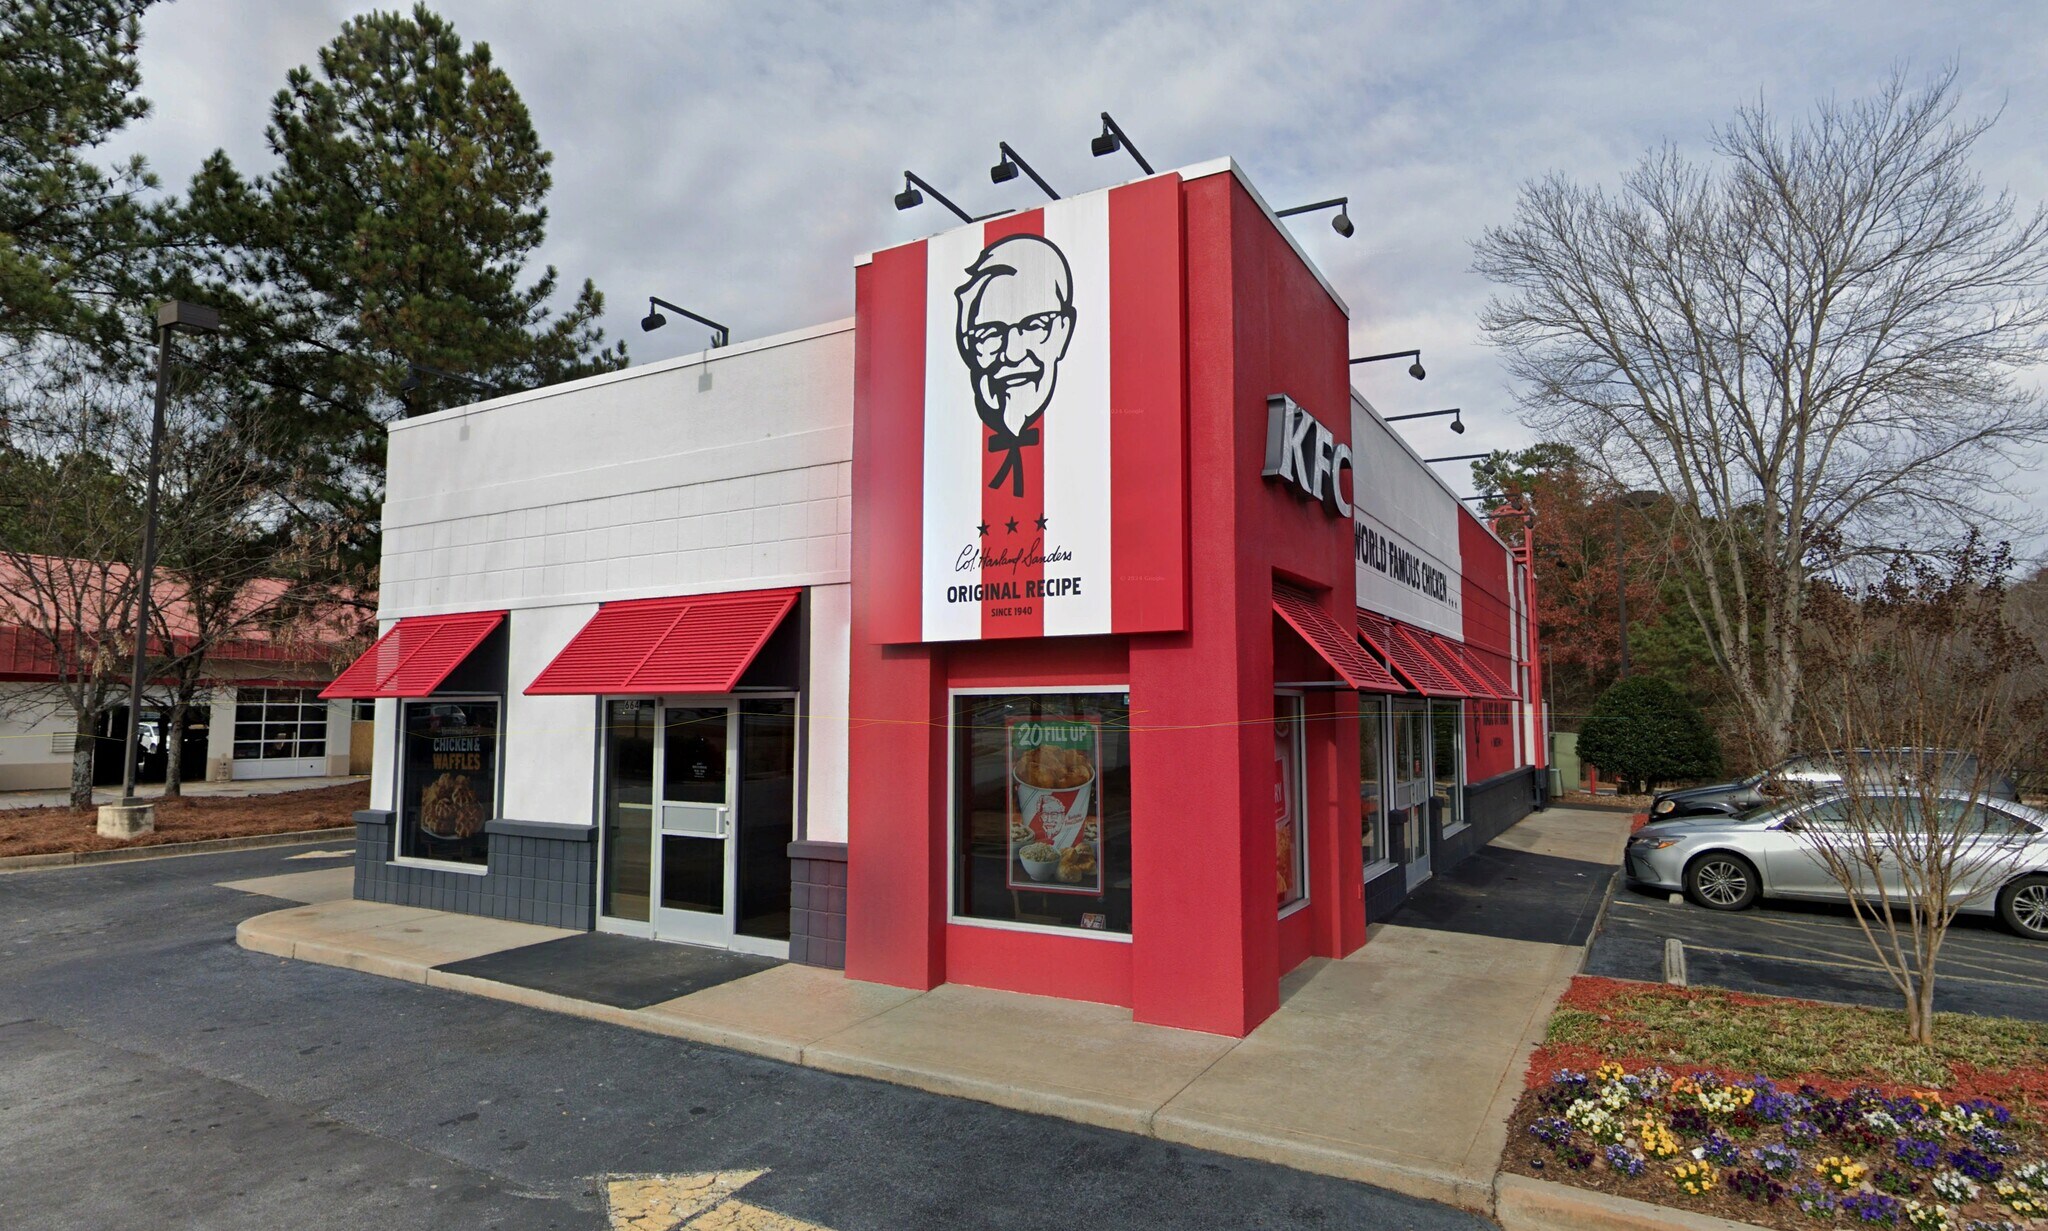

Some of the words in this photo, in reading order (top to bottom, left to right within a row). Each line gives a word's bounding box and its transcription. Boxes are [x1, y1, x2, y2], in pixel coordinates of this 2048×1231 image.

[1262, 392, 1352, 518] KFC
[955, 543, 979, 572] Col.
[1022, 537, 1073, 568] Sanders
[1388, 541, 1420, 590] FAMOUS
[1421, 561, 1447, 604] CHICKEN
[947, 581, 1021, 603] ORIGINAL
[1025, 577, 1082, 598] RECIPE
[991, 607, 1012, 617] SINCE
[1014, 606, 1033, 616] 1940
[1044, 726, 1067, 742] FILL
[1070, 725, 1087, 742] UP
[432, 753, 481, 770] WAFFLES
